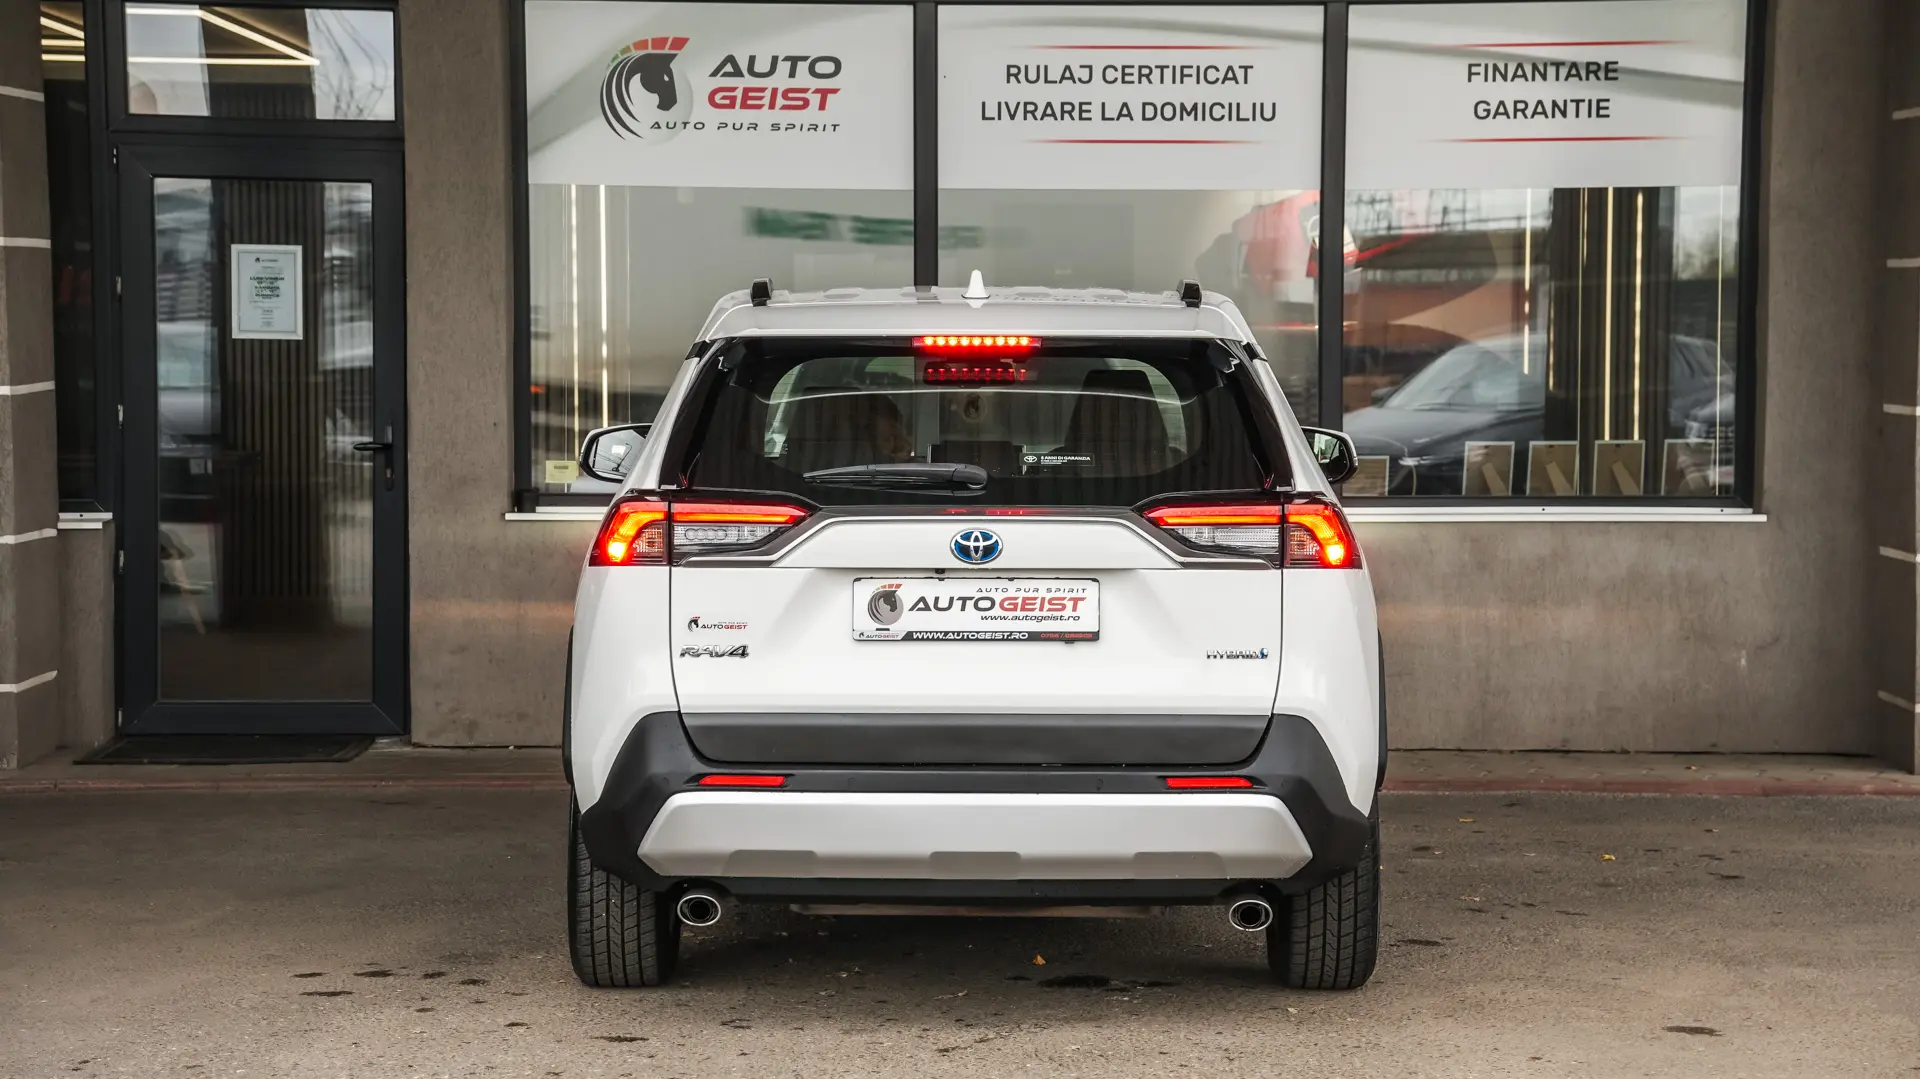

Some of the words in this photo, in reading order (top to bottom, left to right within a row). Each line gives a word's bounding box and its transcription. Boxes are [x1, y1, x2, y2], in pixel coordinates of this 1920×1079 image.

[708, 54, 842, 79] AUTO
[1006, 64, 1094, 84] RULAJ
[1101, 64, 1254, 85] CERTIFICAT
[1467, 61, 1619, 83] FINANTARE
[708, 86, 841, 111] GEIST
[1473, 98, 1611, 120] GARANTIE
[981, 101, 1093, 121] LIVRARE
[1100, 102, 1134, 122] LA
[1141, 102, 1277, 122] DOMICILIU
[650, 121, 706, 130] AUTO
[717, 122, 759, 131] PUR
[770, 122, 841, 132] SPIRIT
[980, 614, 1081, 623] www.autogeist.ro
[912, 632, 1029, 640] WWW.AUTOGEIST.RO
[679, 644, 750, 658] RAV4
[1206, 649, 1260, 660] HYBRID
